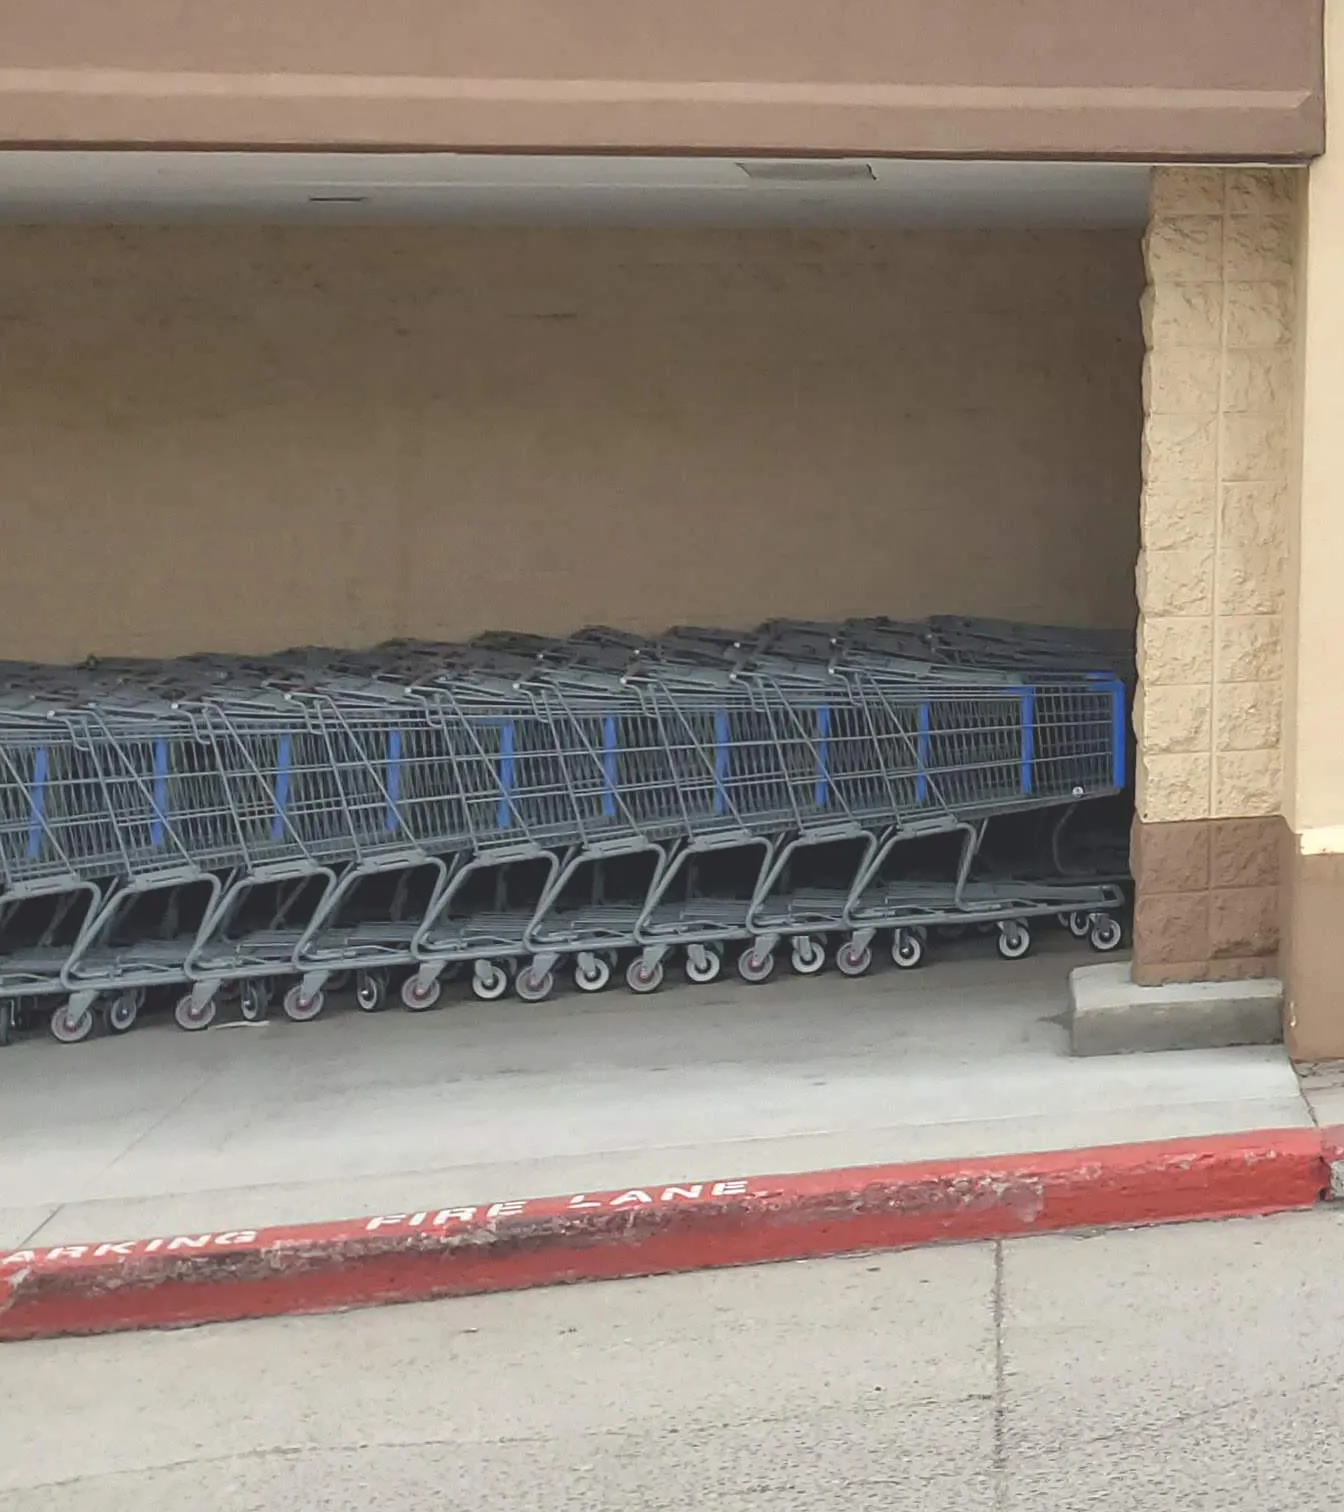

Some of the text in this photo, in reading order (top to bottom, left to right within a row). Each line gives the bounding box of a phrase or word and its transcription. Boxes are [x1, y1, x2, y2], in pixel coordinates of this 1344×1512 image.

[0, 1180, 749, 1266] ARKING FIRE LANE
